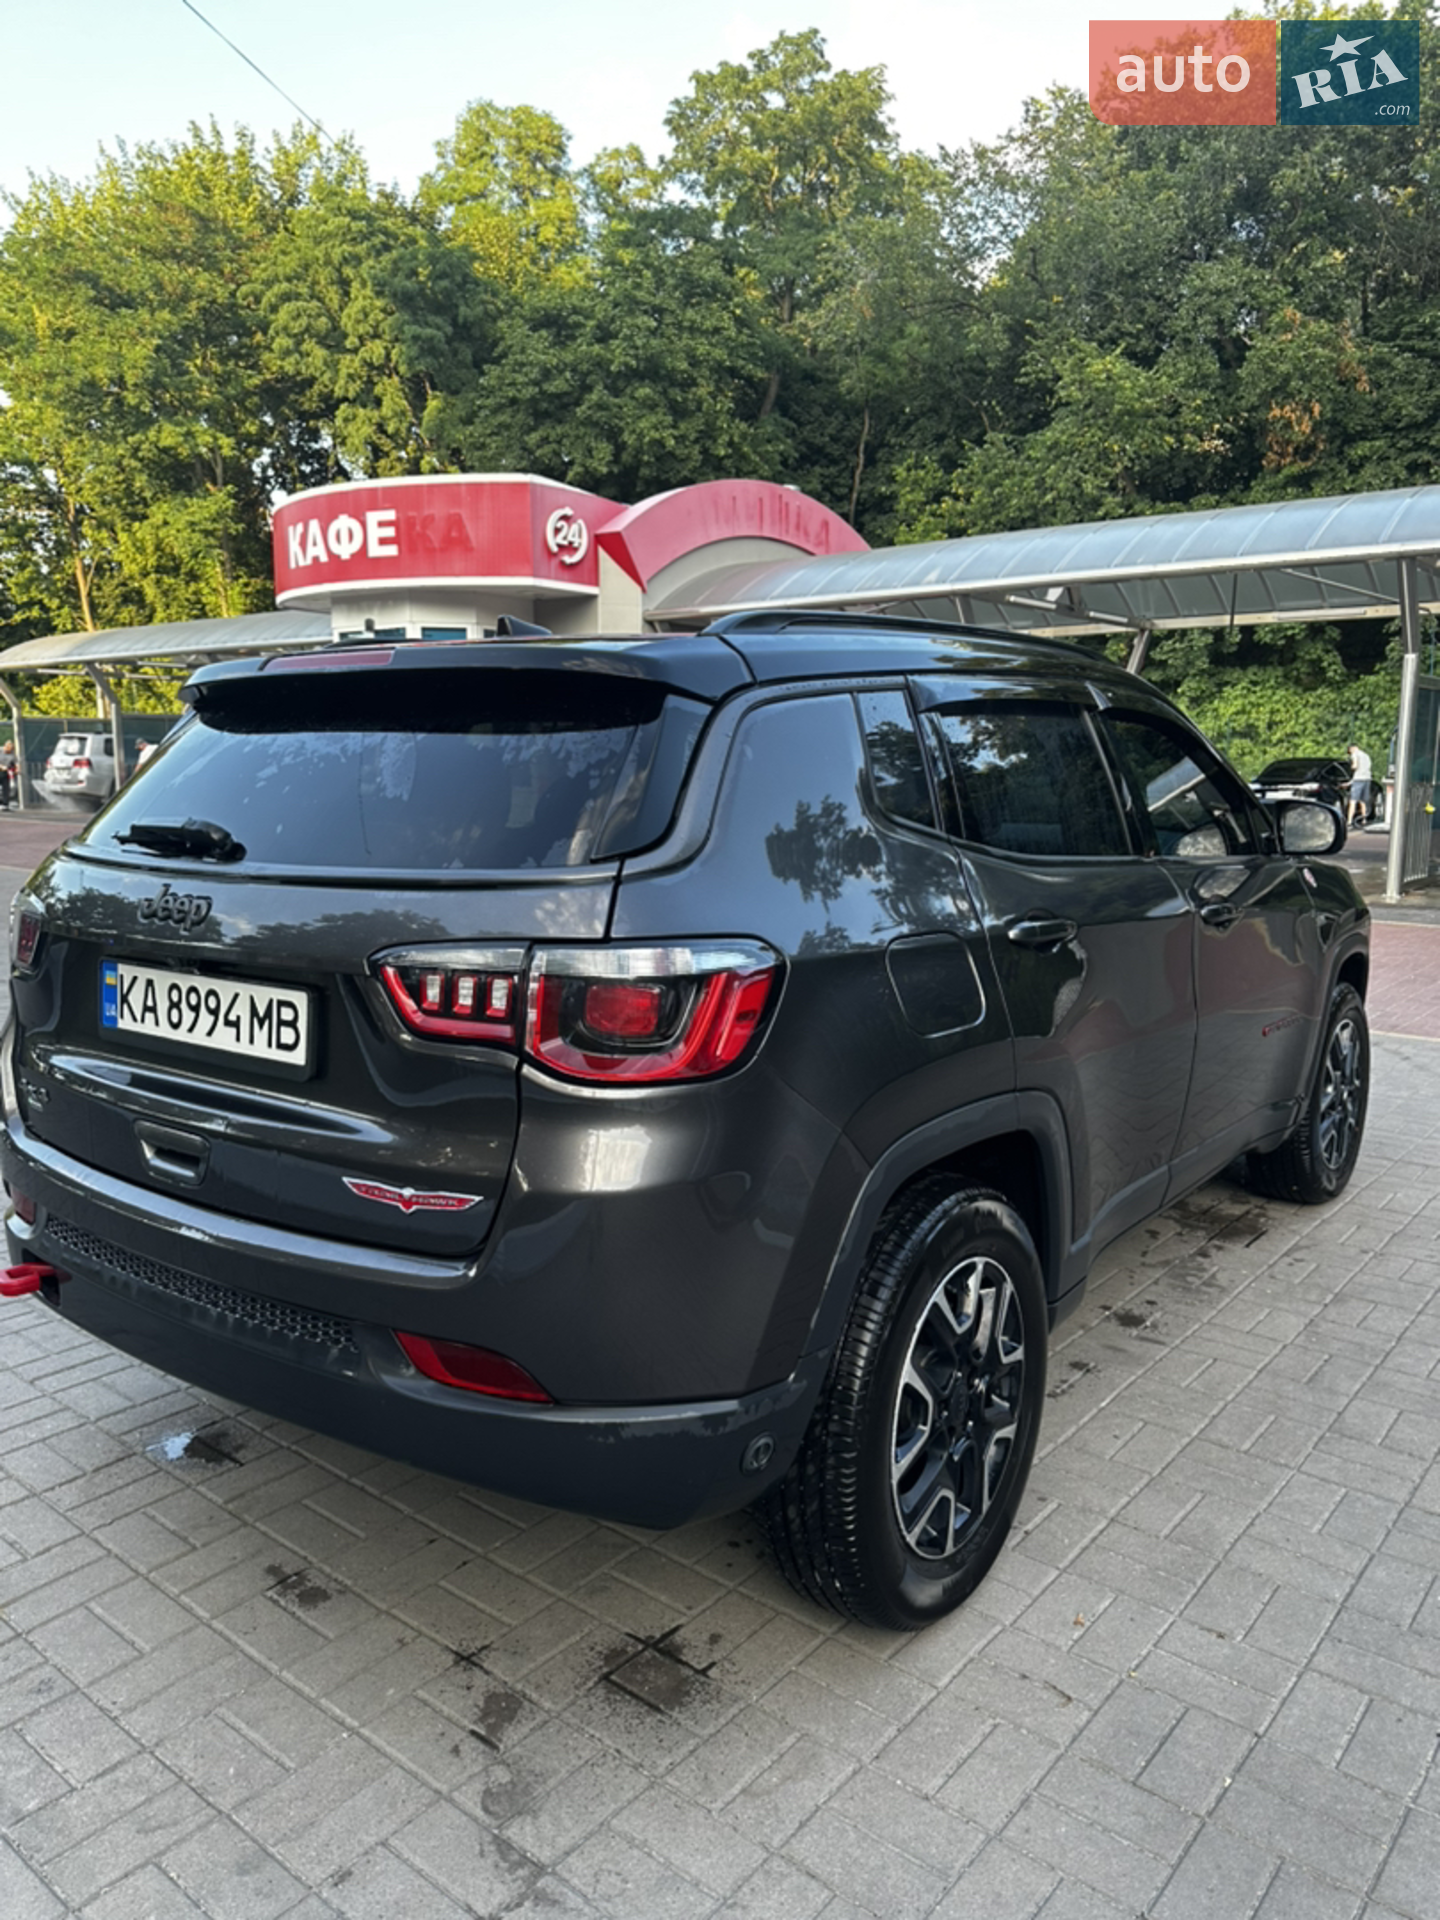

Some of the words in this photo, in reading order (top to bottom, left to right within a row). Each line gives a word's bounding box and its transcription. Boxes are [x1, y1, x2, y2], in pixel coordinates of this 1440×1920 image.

[288, 508, 399, 570] КАФЕ
[555, 521, 582, 548] 24
[138, 883, 213, 935] Jeep
